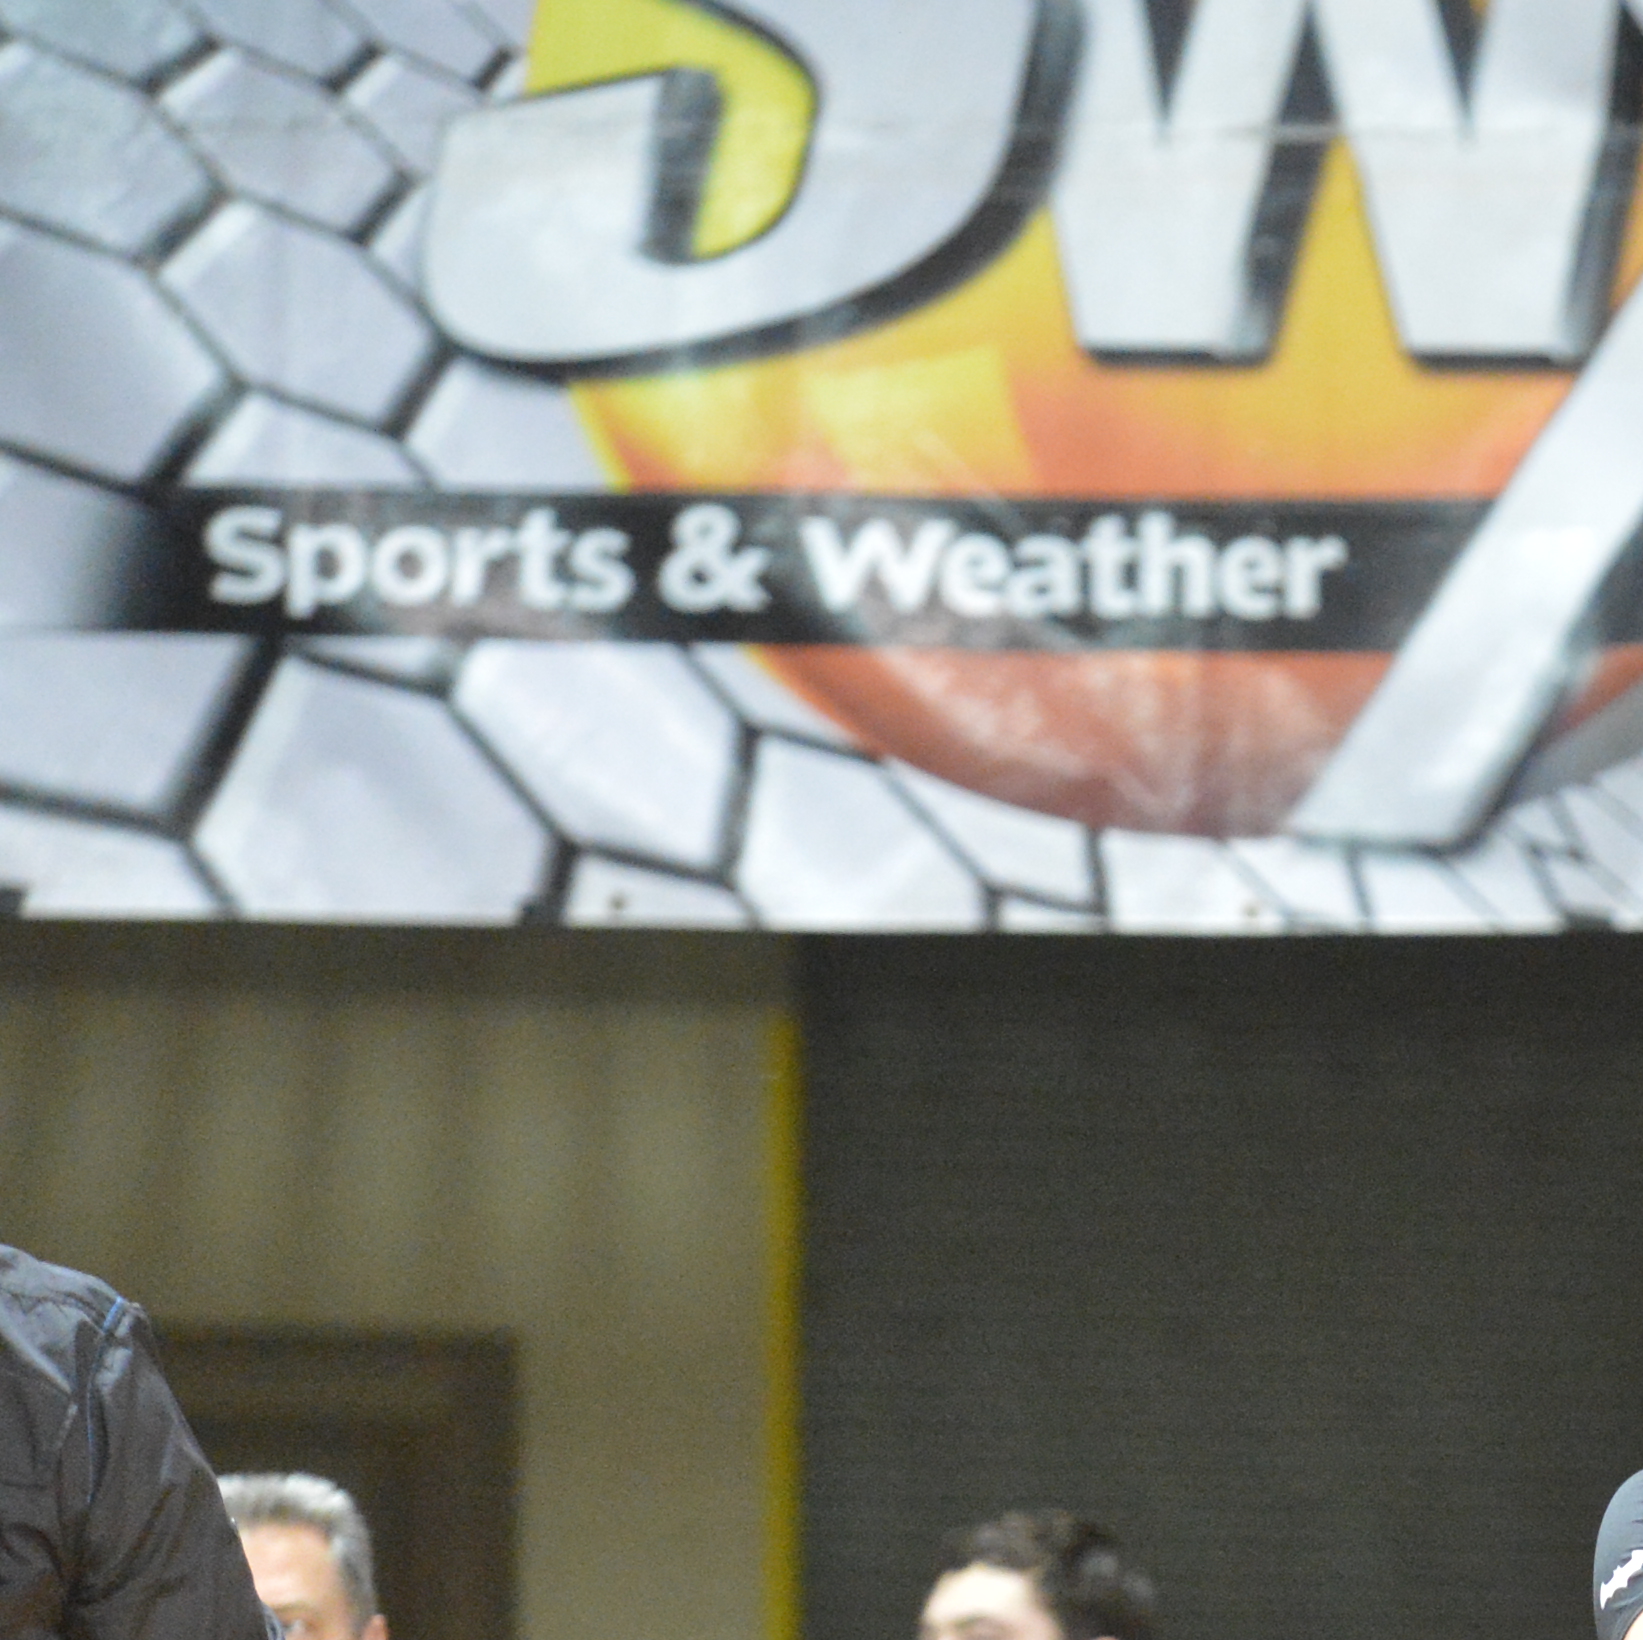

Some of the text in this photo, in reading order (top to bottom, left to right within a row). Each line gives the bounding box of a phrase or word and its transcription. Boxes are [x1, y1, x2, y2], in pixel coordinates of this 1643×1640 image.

[205, 503, 636, 618] Sports
[657, 502, 772, 613] &
[802, 510, 1349, 620] Weather
